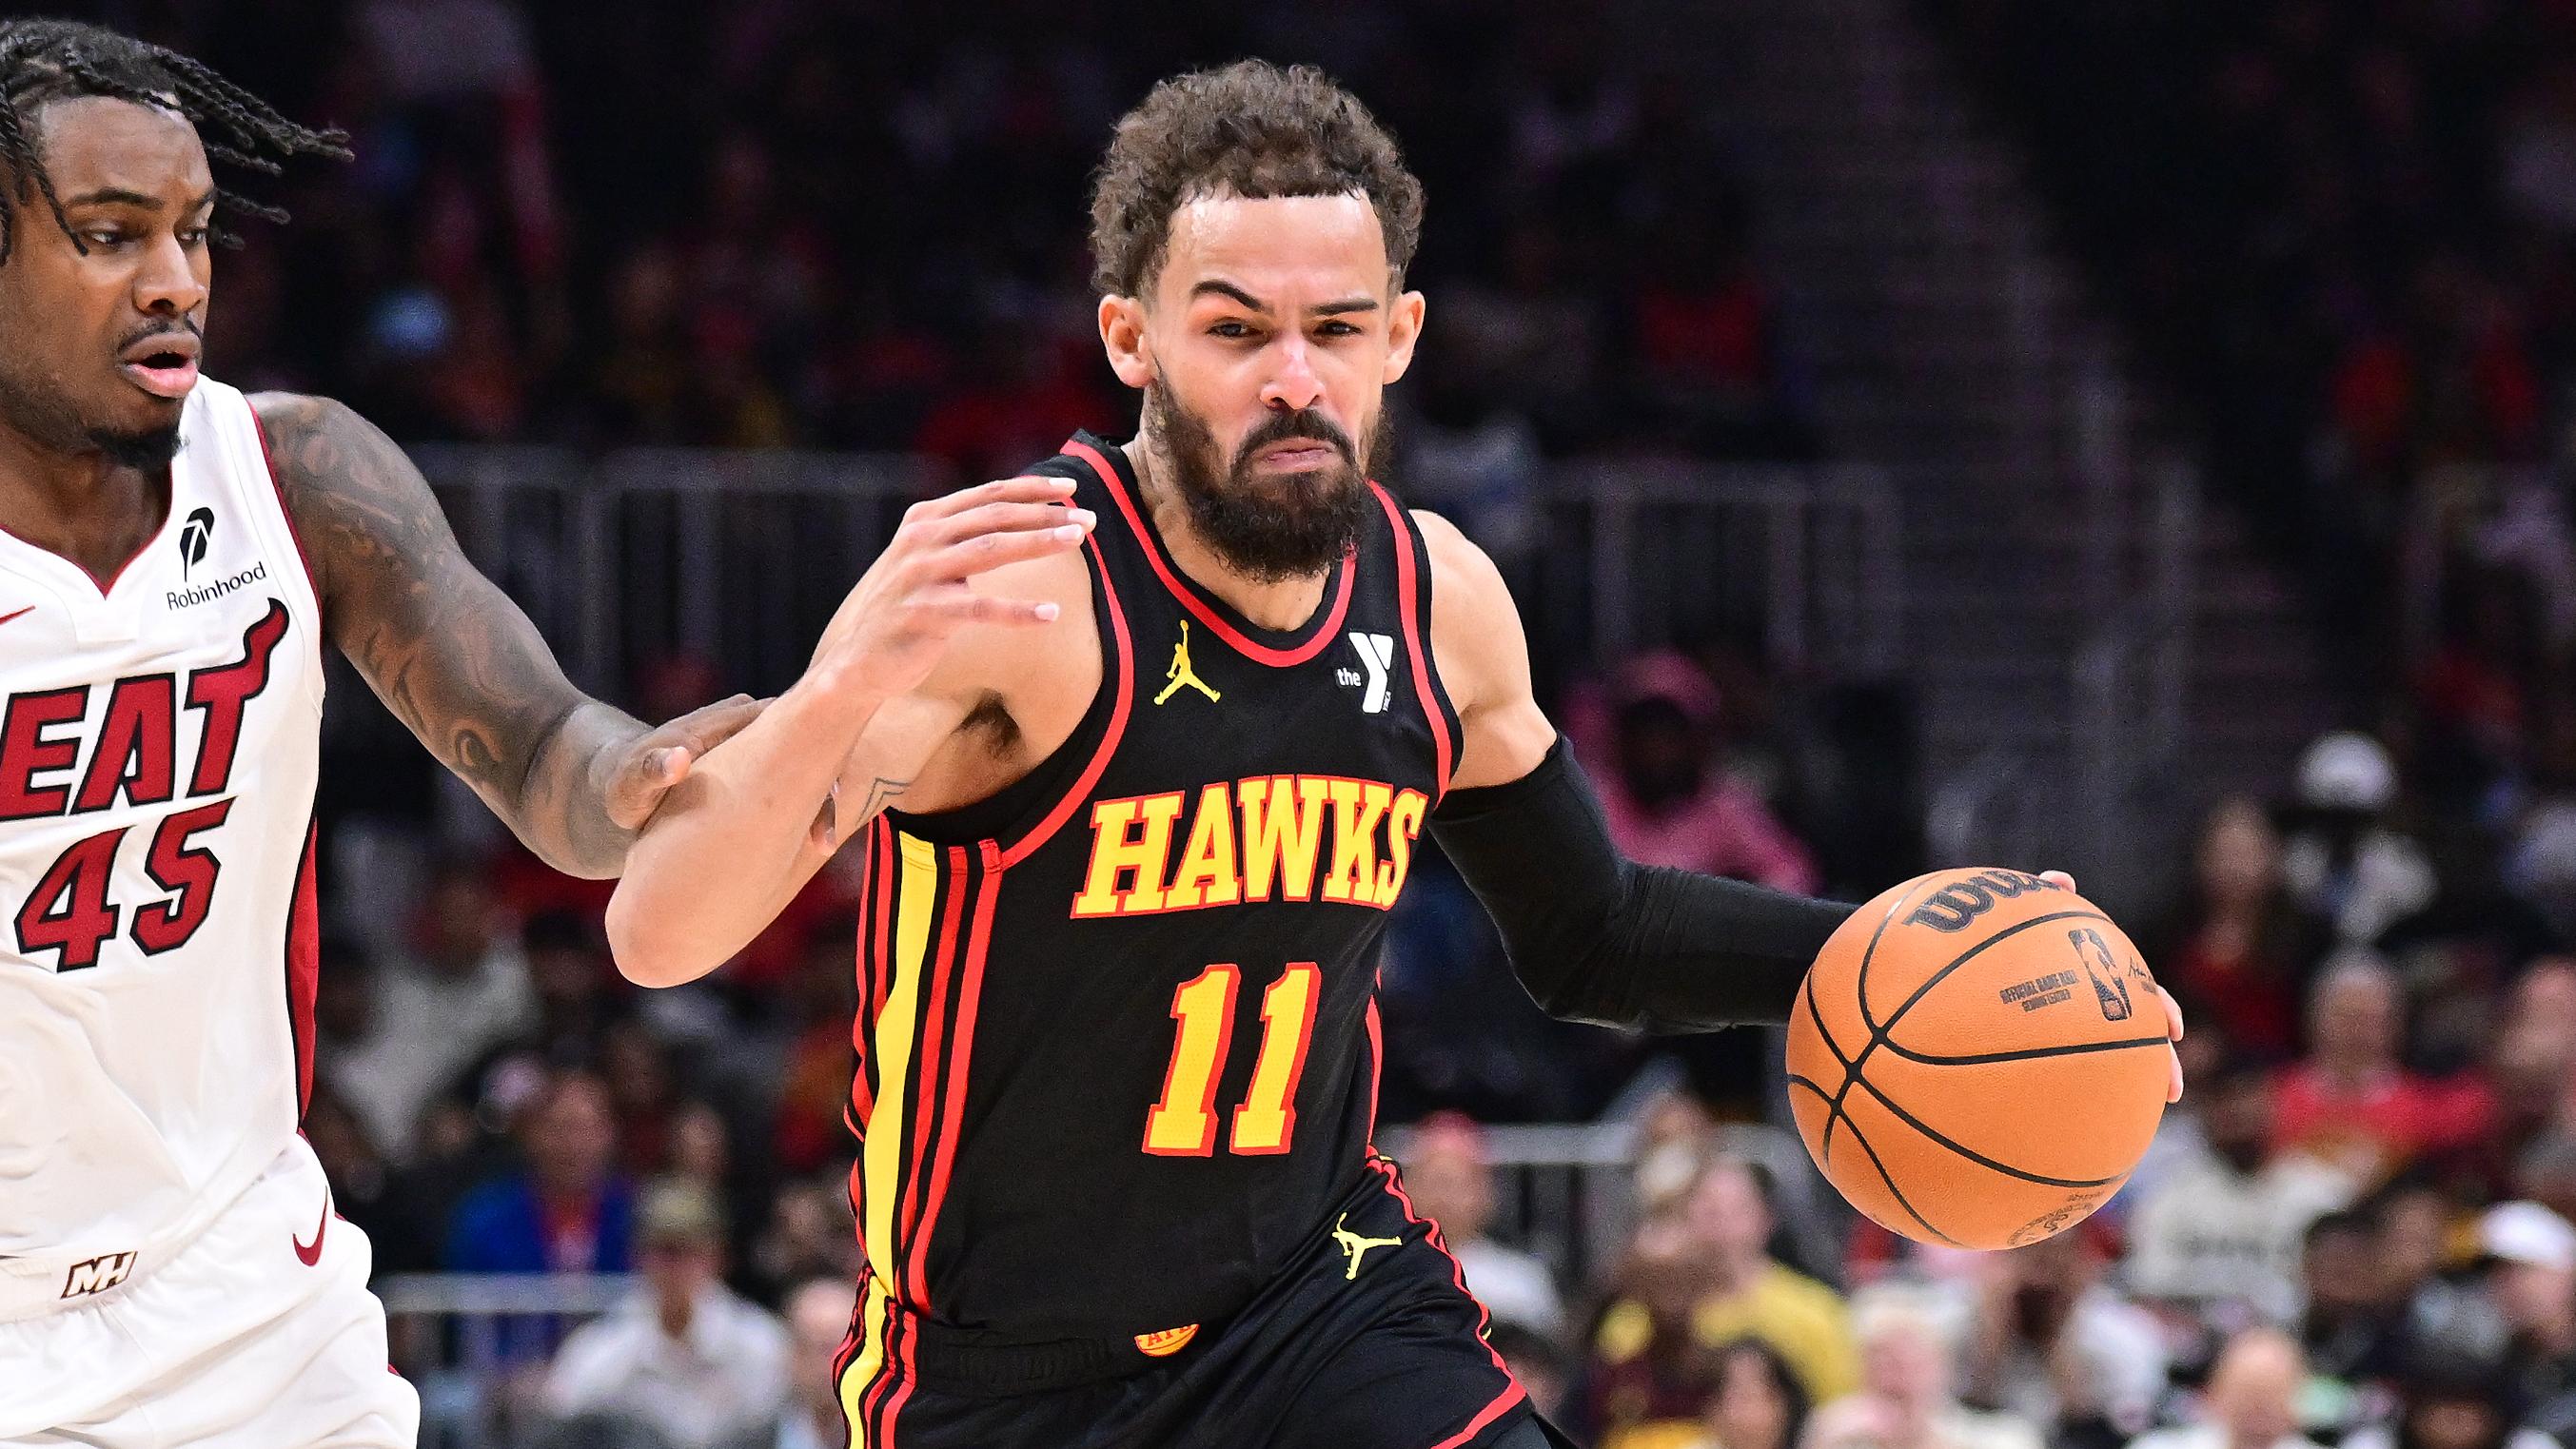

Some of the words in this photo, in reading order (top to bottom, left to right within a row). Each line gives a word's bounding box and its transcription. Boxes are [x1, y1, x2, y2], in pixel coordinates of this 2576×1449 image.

[166, 560, 267, 611] Robinhood
[1336, 667, 1362, 687] the
[14, 795, 239, 973] 45
[1071, 773, 1428, 919] HAWKS
[1141, 961, 1322, 1157] 11
[60, 1251, 139, 1301] MH
